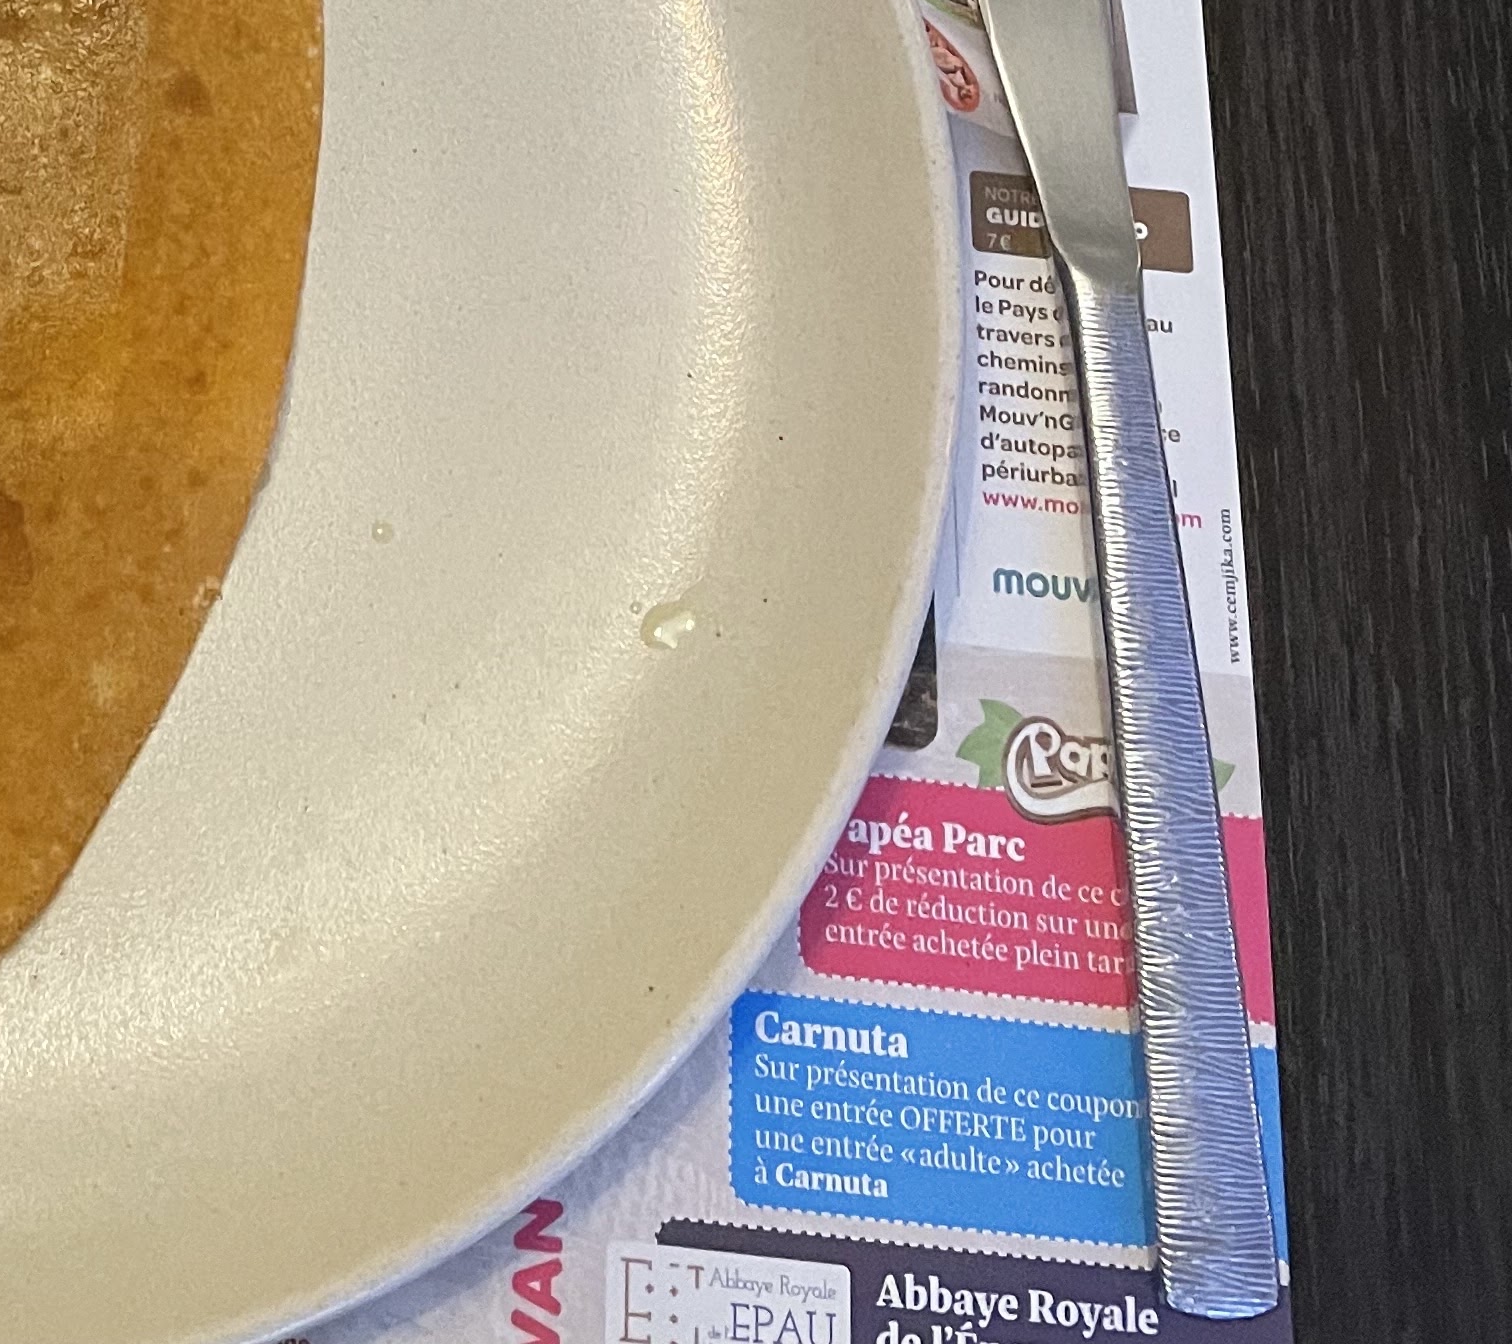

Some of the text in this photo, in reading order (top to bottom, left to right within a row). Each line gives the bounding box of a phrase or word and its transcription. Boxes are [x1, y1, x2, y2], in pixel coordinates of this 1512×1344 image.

[986, 207, 1045, 228] GUID
[974, 270, 1025, 291] Pour
[997, 299, 1048, 325] Pays
[976, 325, 1055, 348] travers
[977, 351, 1070, 377] chemins
[1217, 508, 1241, 664] www.cemjika.com
[847, 812, 1026, 862] apéa Parc
[875, 857, 1104, 904] présentation de ce
[825, 885, 1078, 935] 2 de réduction sur
[825, 923, 1080, 971] entrée achetée plein
[754, 1010, 909, 1059] Carnuta
[754, 1053, 1141, 1123] Sur présentation de ce coupon
[754, 1093, 1096, 1153] une entrée OFFERTE pour
[754, 1129, 805, 1153] une
[811, 1135, 894, 1163] entrée
[1027, 1155, 1126, 1188] achetée
[776, 1162, 889, 1198] Carnuta
[709, 1270, 836, 1301] Abbaye Royale
[876, 1273, 1159, 1339] Abbaye Royale
[731, 1302, 836, 1344] EPAU
